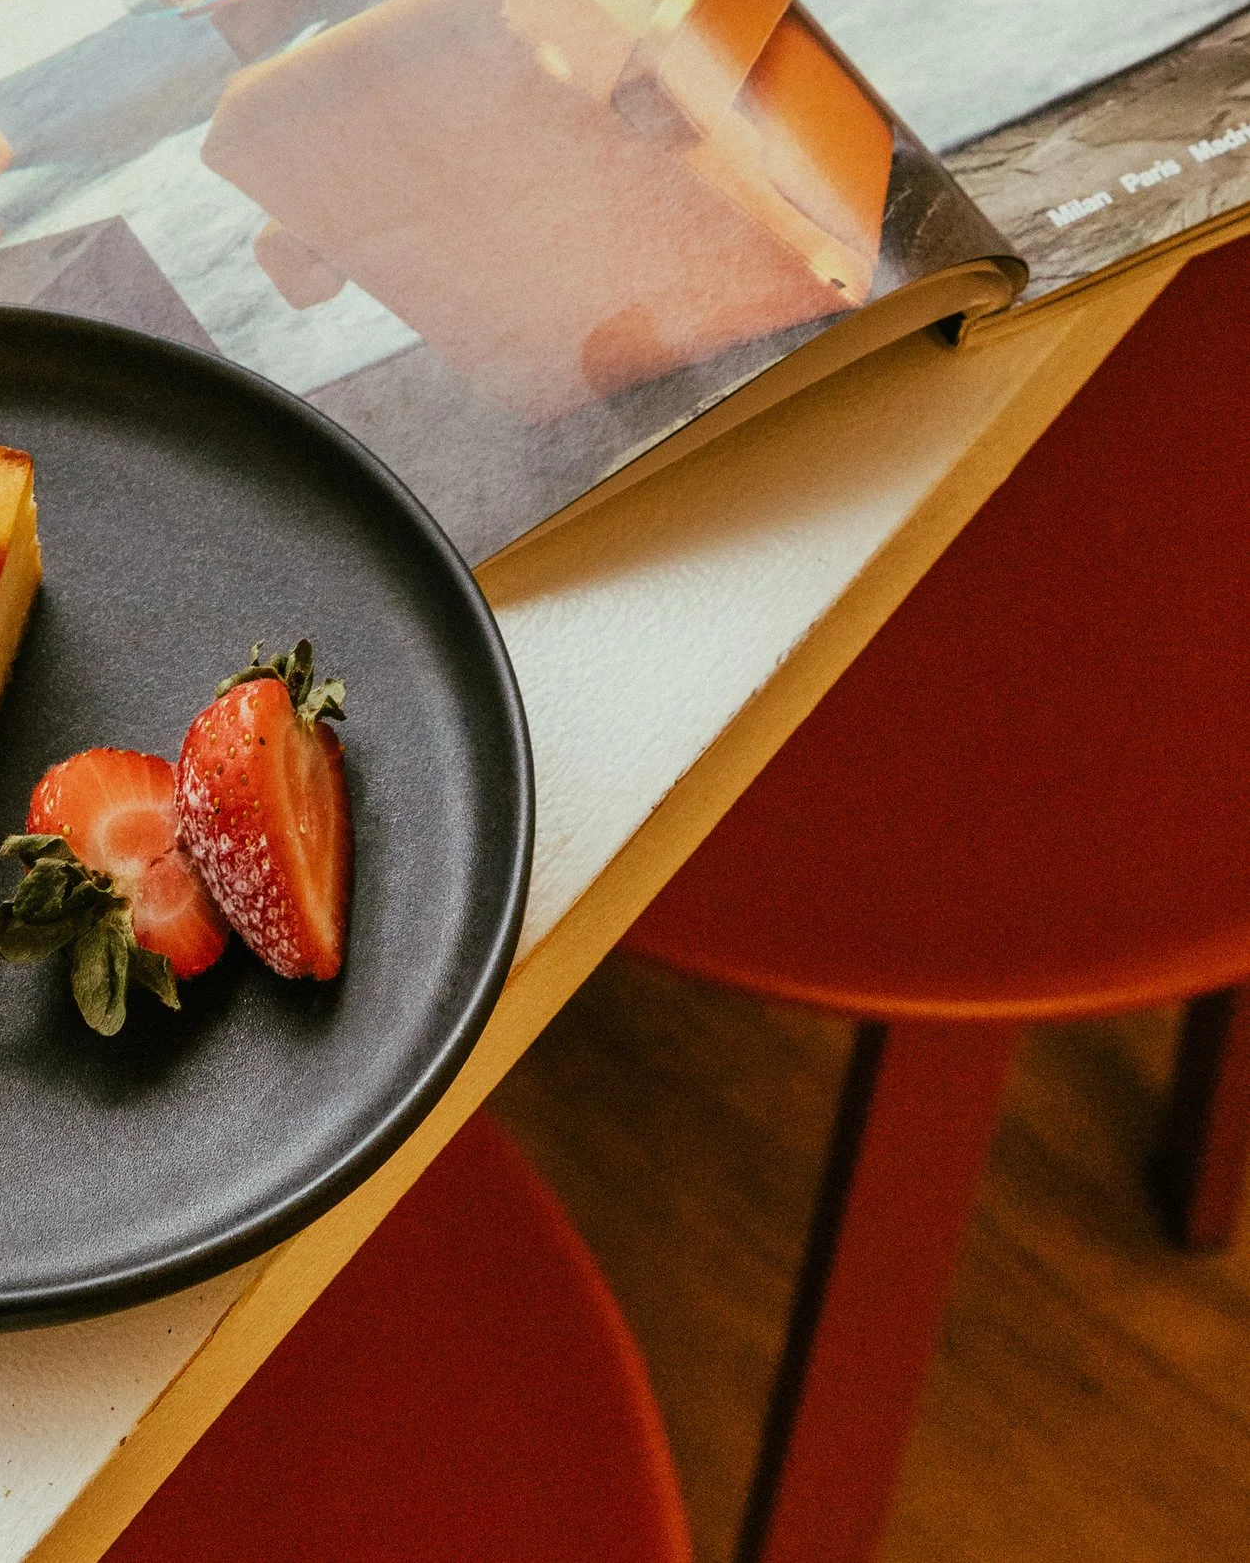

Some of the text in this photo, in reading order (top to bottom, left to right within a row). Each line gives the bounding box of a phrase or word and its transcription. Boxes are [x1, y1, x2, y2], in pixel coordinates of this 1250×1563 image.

[1046, 122, 1250, 228] Milan Paris Madri
